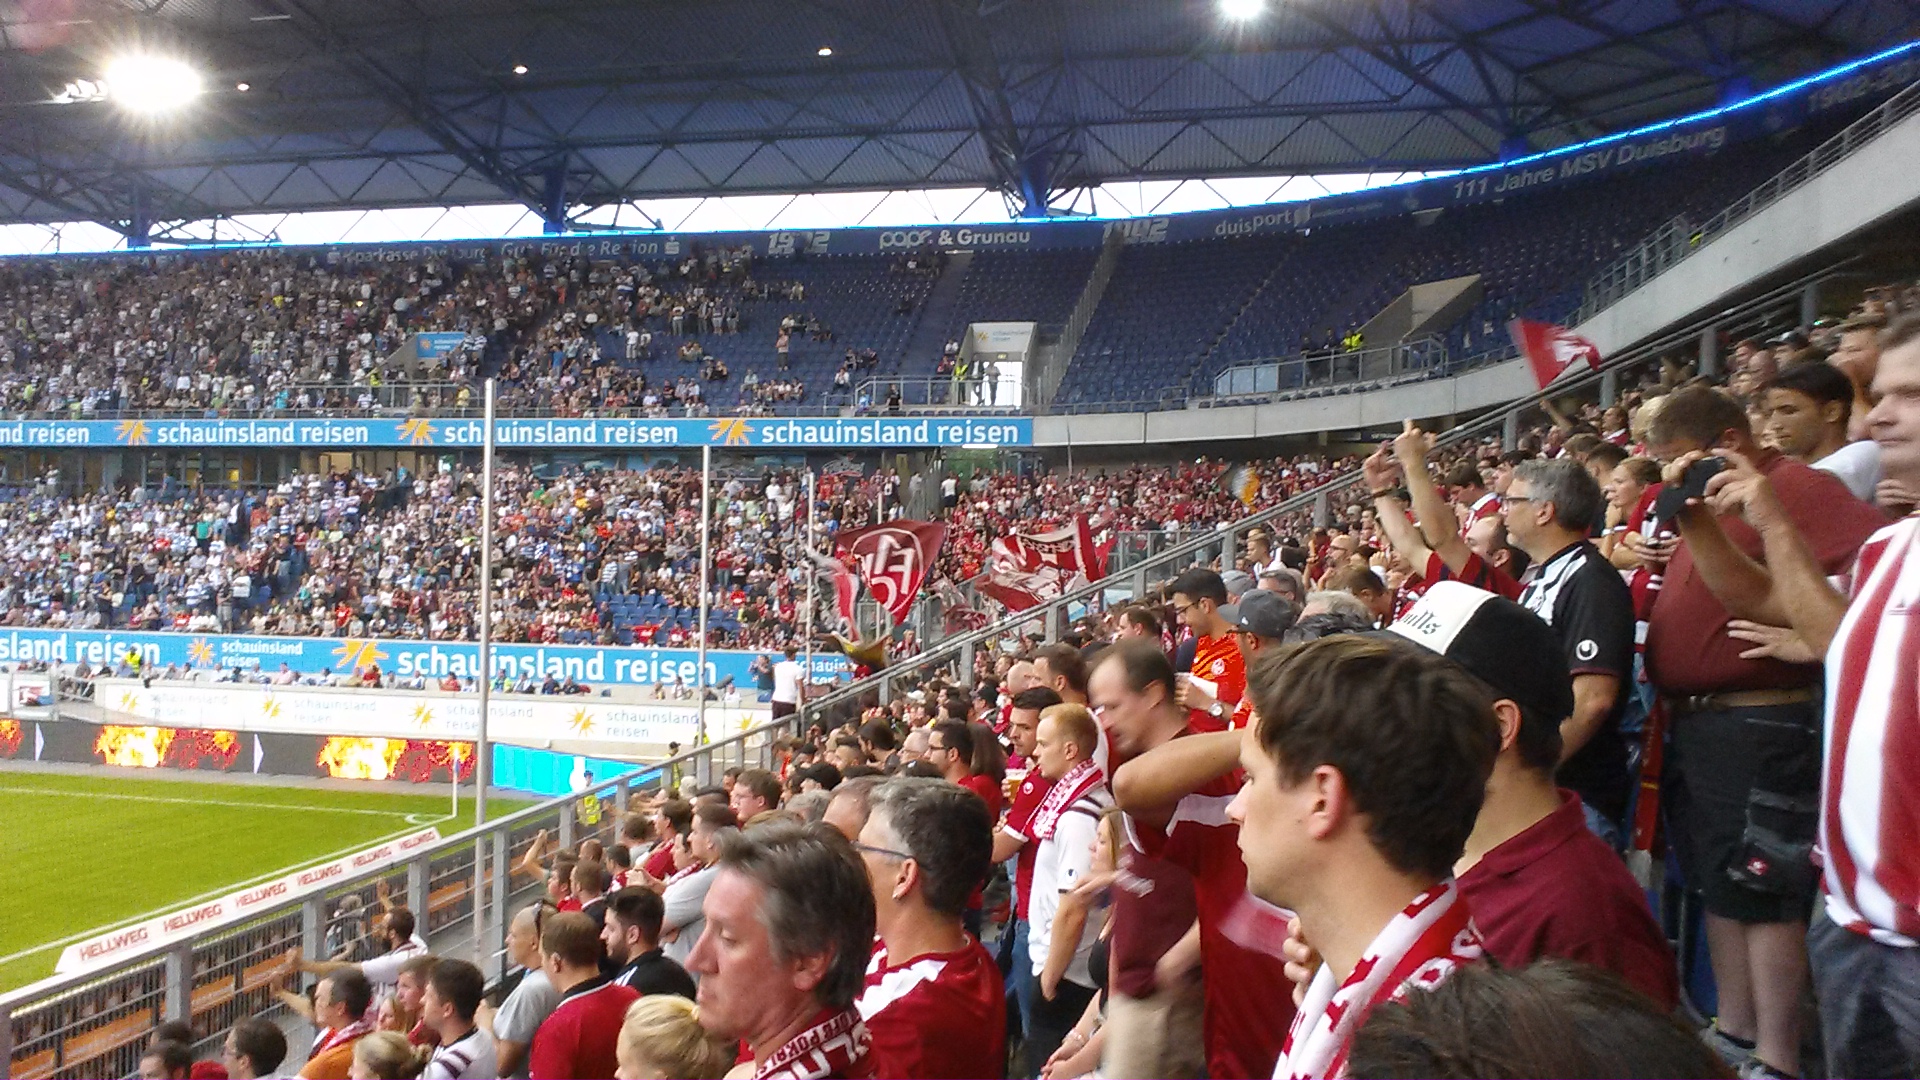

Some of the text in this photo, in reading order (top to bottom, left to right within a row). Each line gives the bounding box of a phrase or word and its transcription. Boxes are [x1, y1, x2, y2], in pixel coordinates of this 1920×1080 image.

[1453, 126, 1727, 199] 111 Jahre MSV Duisburg
[1215, 208, 1292, 236] duisport
[938, 230, 954, 245] &
[957, 228, 1031, 245] Grunau
[601, 239, 659, 256] Reion
[29, 422, 90, 443] reisen
[157, 421, 369, 443] schauinsland reisen
[444, 421, 679, 443] schuinsland reisen
[762, 420, 1018, 443] schauinsland reisen
[222, 639, 304, 655] schauinsland
[222, 653, 260, 668] reisen
[398, 645, 717, 685] schauinsland reisen
[294, 698, 377, 712] schauinsland
[446, 704, 534, 718] schansland
[294, 712, 333, 724] reisen
[446, 720, 480, 730] reise
[606, 709, 698, 725] schauinsland
[606, 726, 649, 738] reisen
[297, 863, 343, 887] HELLWEG
[235, 882, 287, 909] HELLWEG
[163, 903, 223, 933] HELLWEG
[79, 926, 150, 962] HELLWEG
